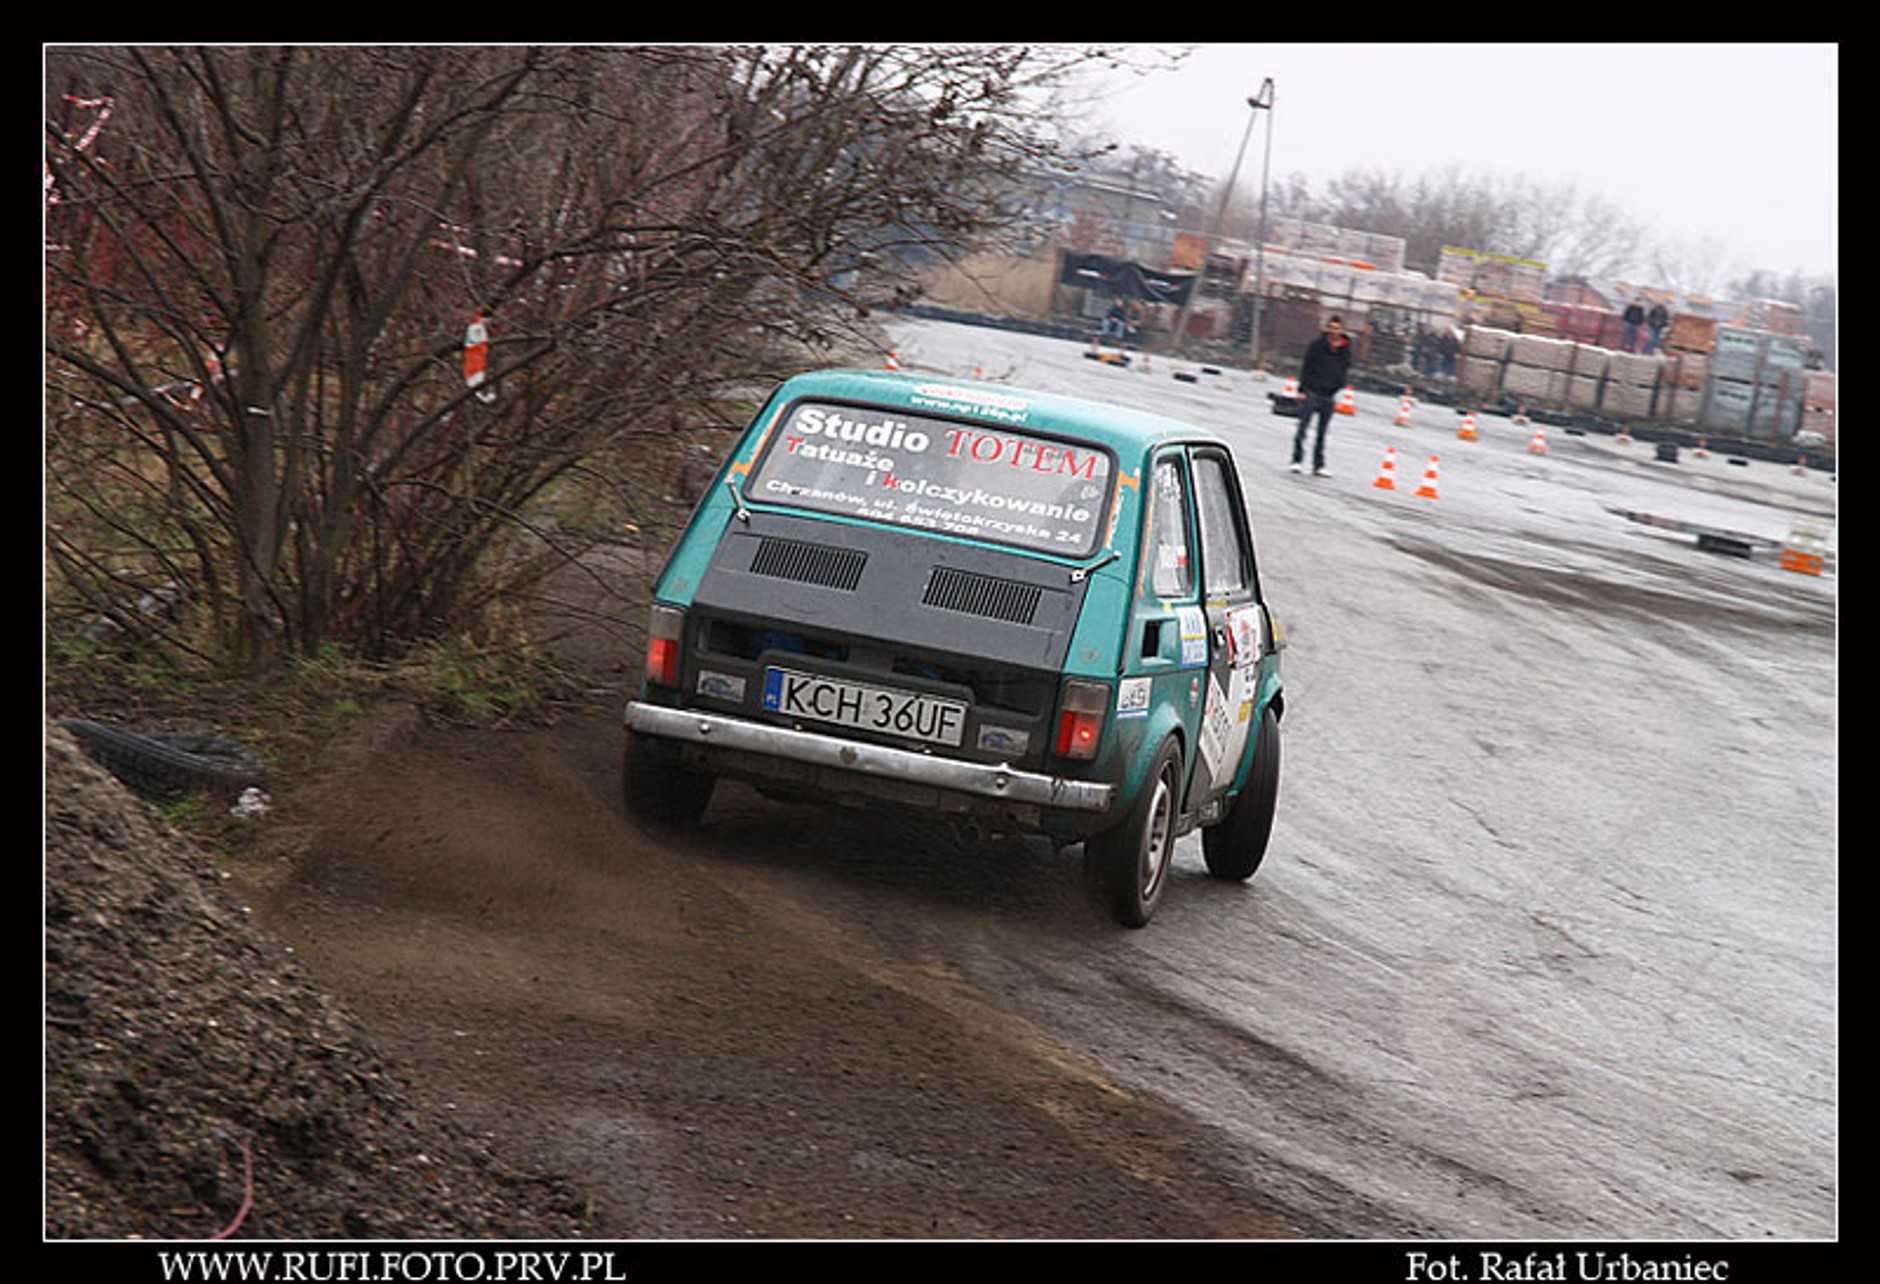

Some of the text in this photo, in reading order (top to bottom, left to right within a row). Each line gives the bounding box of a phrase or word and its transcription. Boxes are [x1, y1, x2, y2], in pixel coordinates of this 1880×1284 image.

[786, 436, 895, 472] Tatuaże
[796, 408, 1097, 480] Studio TOTEM
[883, 473, 1090, 523] kolczykowanie
[1055, 530, 1083, 544] 24
[785, 676, 863, 724] KCH
[871, 694, 963, 740] 36UF
